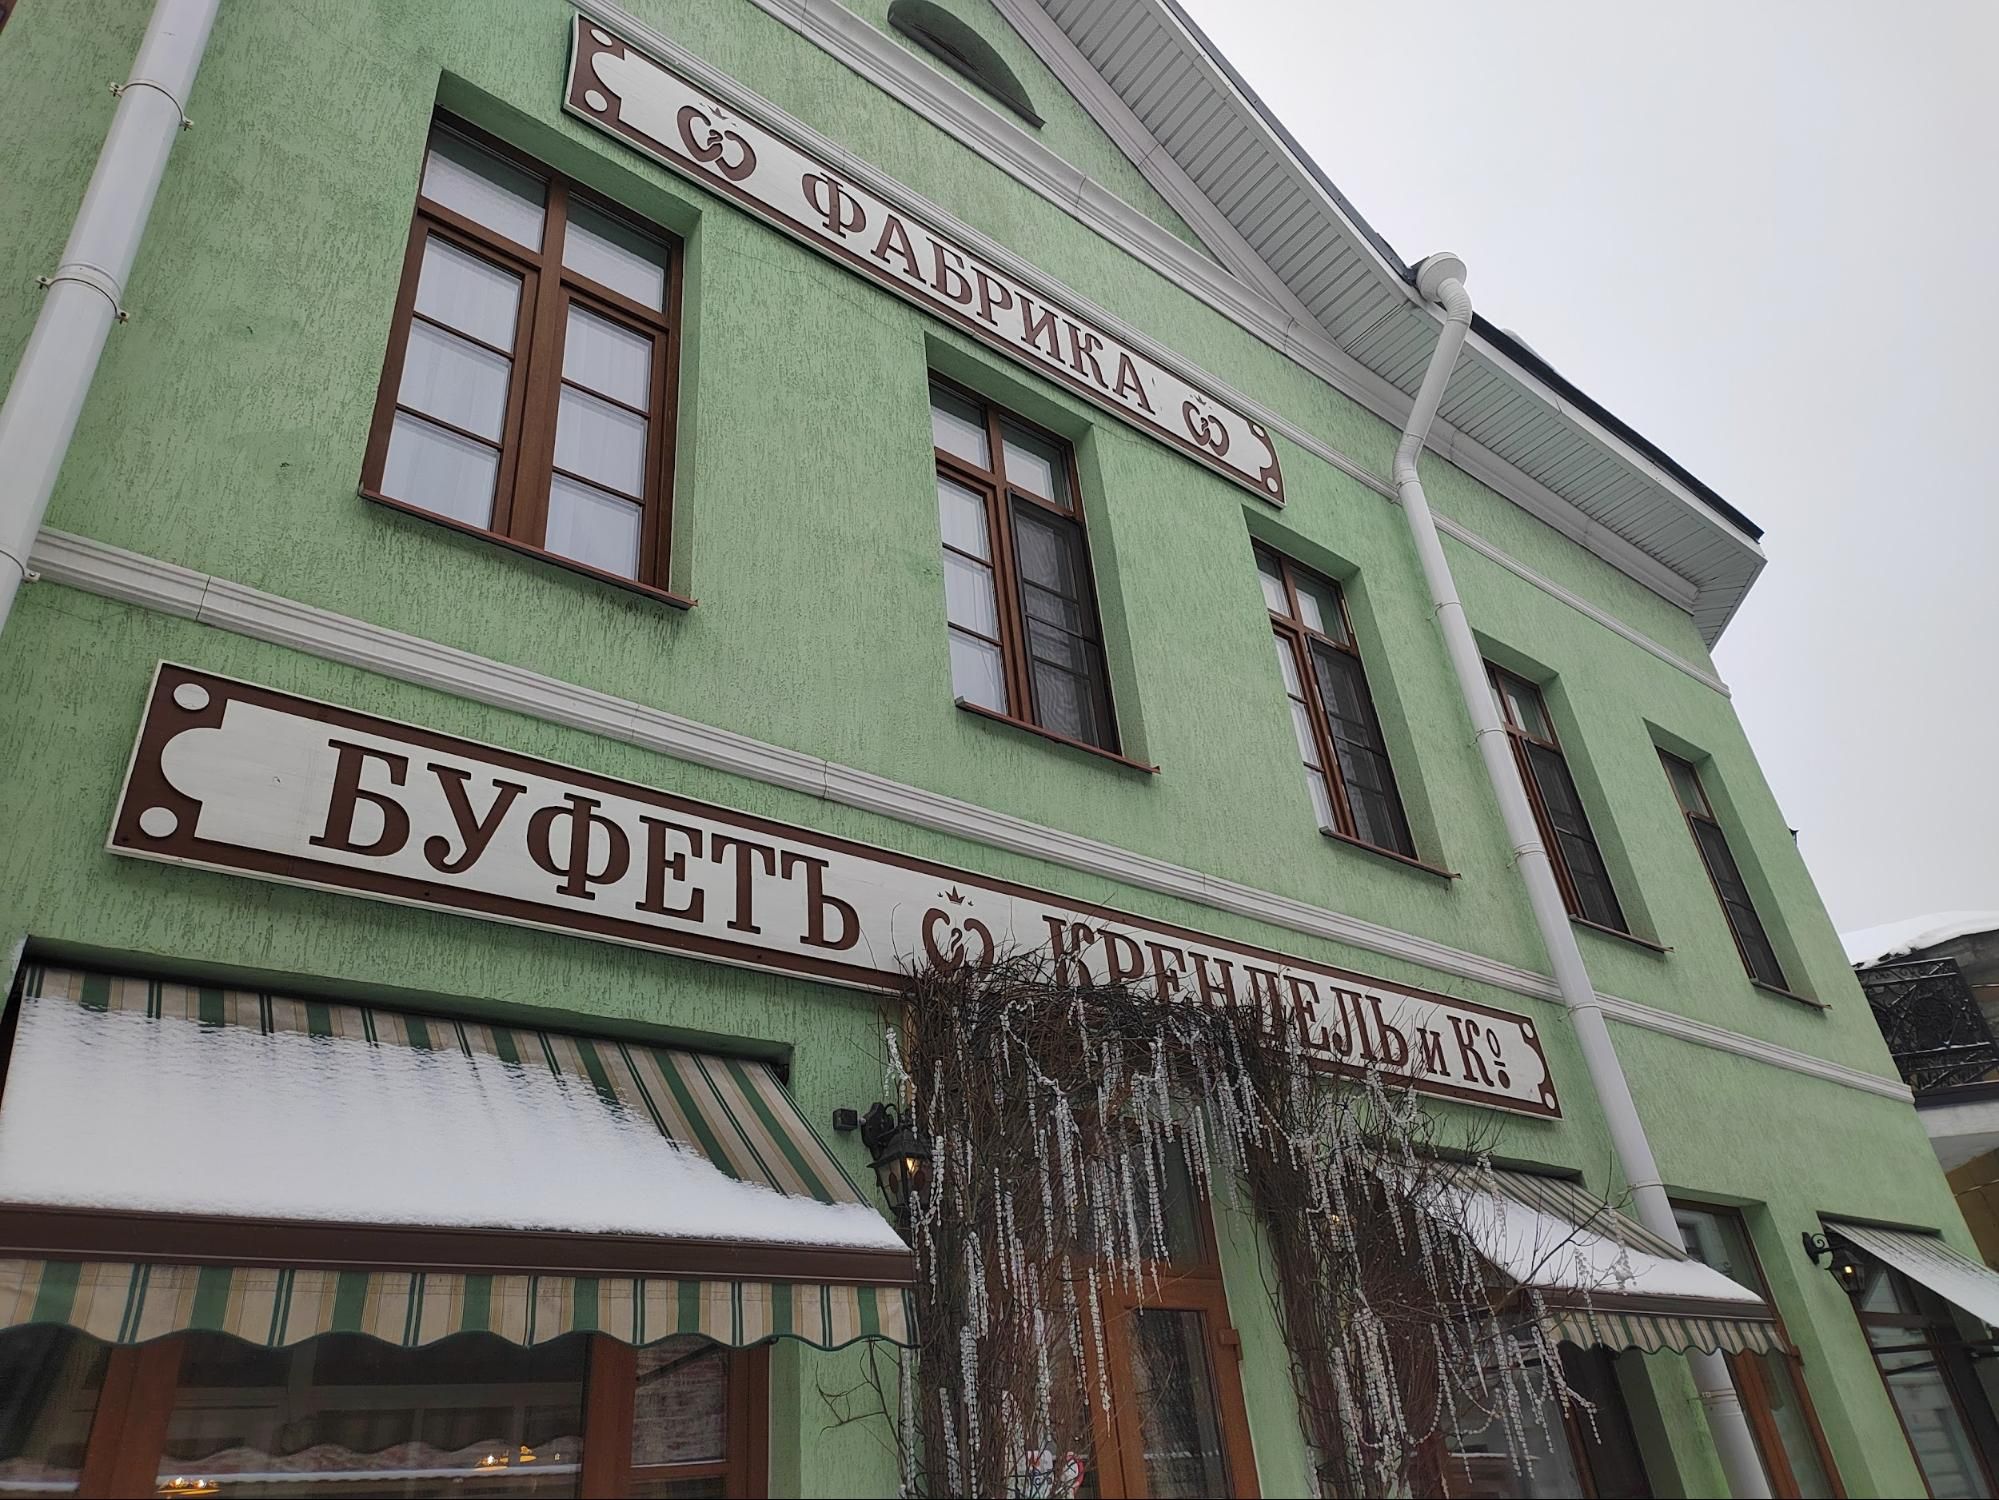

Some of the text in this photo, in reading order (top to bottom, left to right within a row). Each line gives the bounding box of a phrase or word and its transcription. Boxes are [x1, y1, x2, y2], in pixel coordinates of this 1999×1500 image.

[802, 172, 1156, 416] ФАБРИКА
[309, 738, 861, 952] БУФЕТЪ
[1042, 915, 1409, 1067] КРЕНДЕЛЬ
